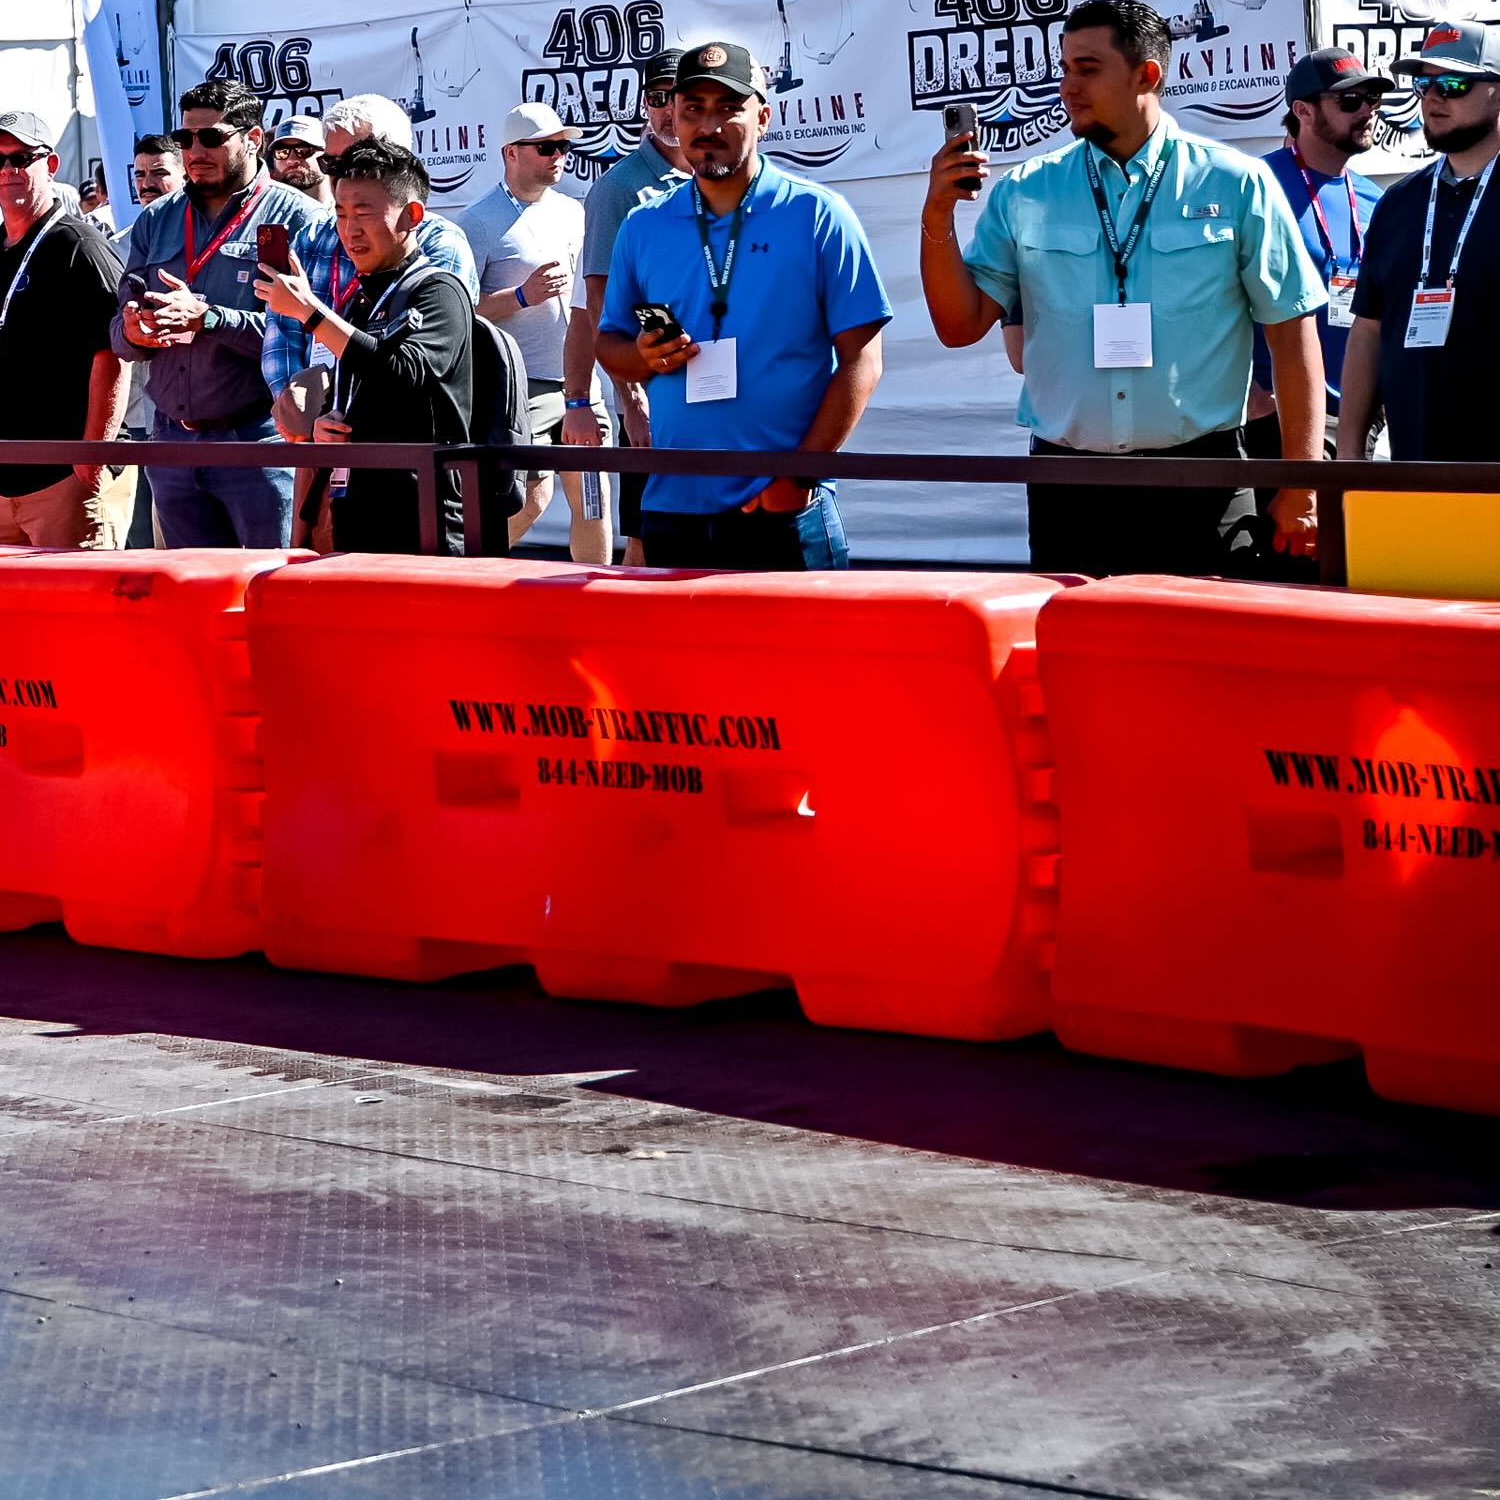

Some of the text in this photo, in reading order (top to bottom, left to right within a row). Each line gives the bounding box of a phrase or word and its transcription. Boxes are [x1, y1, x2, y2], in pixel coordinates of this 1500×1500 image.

[543, 0, 665, 67] 406
[1219, 75, 1280, 92] EXCAVATING
[794, 123, 850, 140] EXCAVATING
[851, 123, 866, 134] INC
[427, 152, 487, 168] EXCAVATING INC
[449, 699, 782, 751] WWW.MOB-TRAFFIC.COM
[537, 757, 703, 795] 844-NEED-MOB
